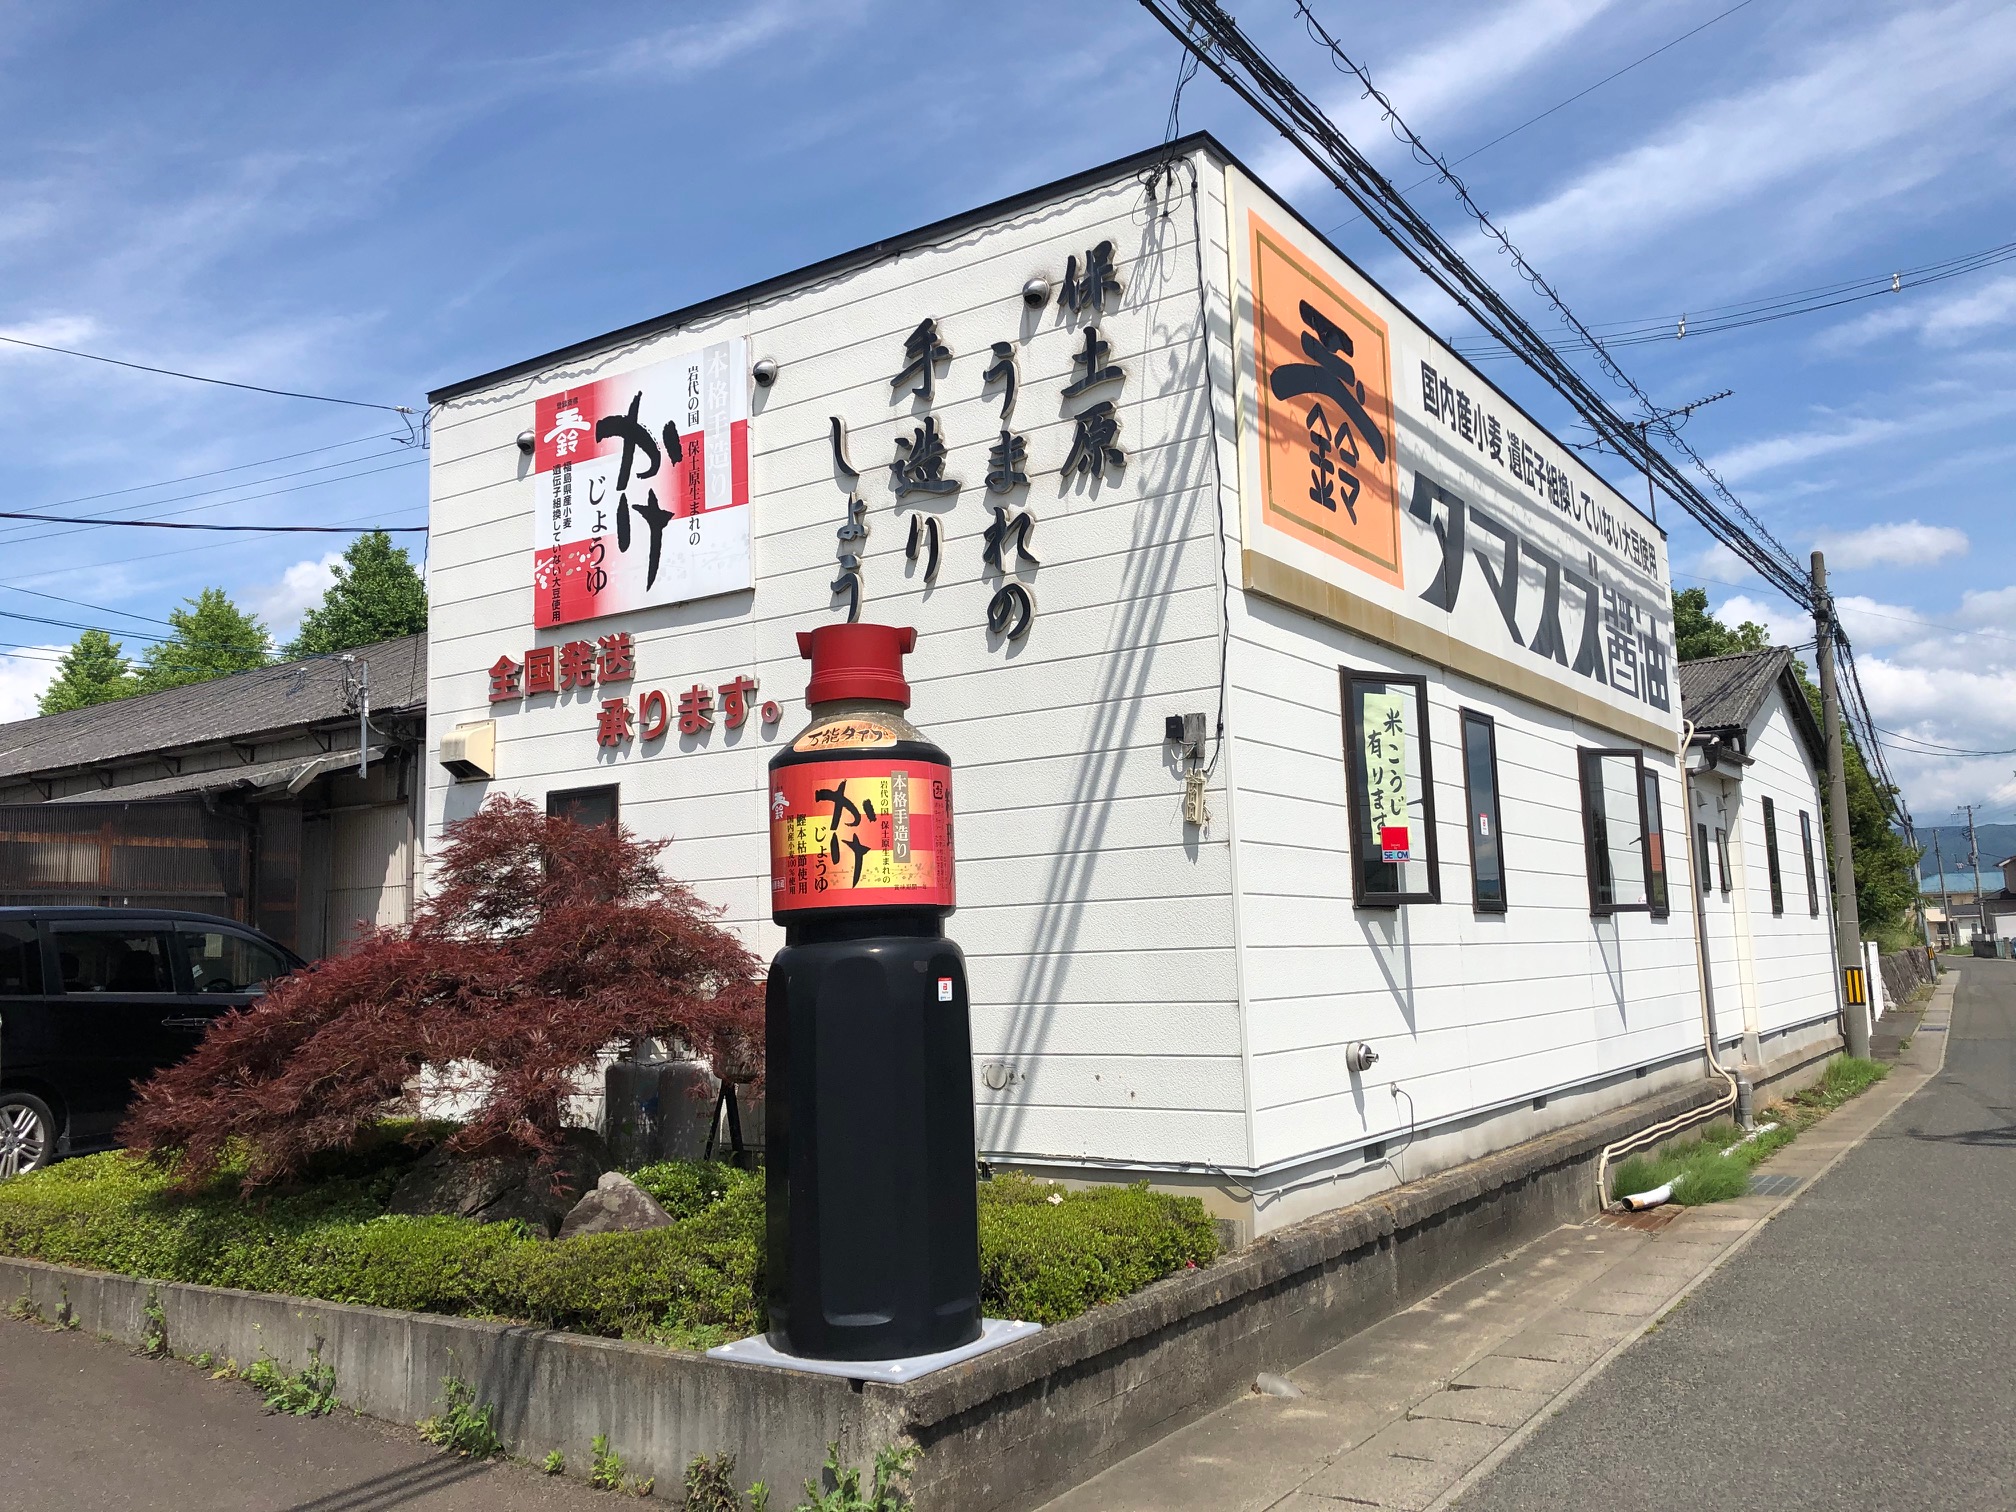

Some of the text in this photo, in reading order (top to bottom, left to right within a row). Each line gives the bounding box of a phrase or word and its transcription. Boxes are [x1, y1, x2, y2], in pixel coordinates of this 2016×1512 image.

[1057, 240, 1127, 479] 保土原
[687, 366, 701, 546] 岩代の国 保土原生まれの
[707, 350, 730, 497] 本格手造り
[889, 318, 962, 583] 手造り
[1421, 360, 1659, 580] 国内産小麦 遺伝子組換していない大豆使用
[551, 464, 562, 622] 遺伝子組換していない大豆使用
[563, 461, 572, 529] 福島県産小麦
[586, 477, 608, 597] じょうゆ
[596, 391, 683, 592] かけ
[983, 341, 1040, 640] うまれの
[1408, 470, 1671, 713] タマスズ醤油
[488, 632, 635, 702] 全国発送
[597, 675, 784, 747] 承ります。
[808, 726, 889, 746] 万能タイプ
[1384, 708, 1403, 816] 米こうじ
[815, 779, 877, 889] かけ
[880, 780, 889, 816] 岩代の国
[893, 774, 909, 858] 本格手造り
[1384, 851, 1408, 859] SECOM
[814, 826, 829, 894] じょうゆ
